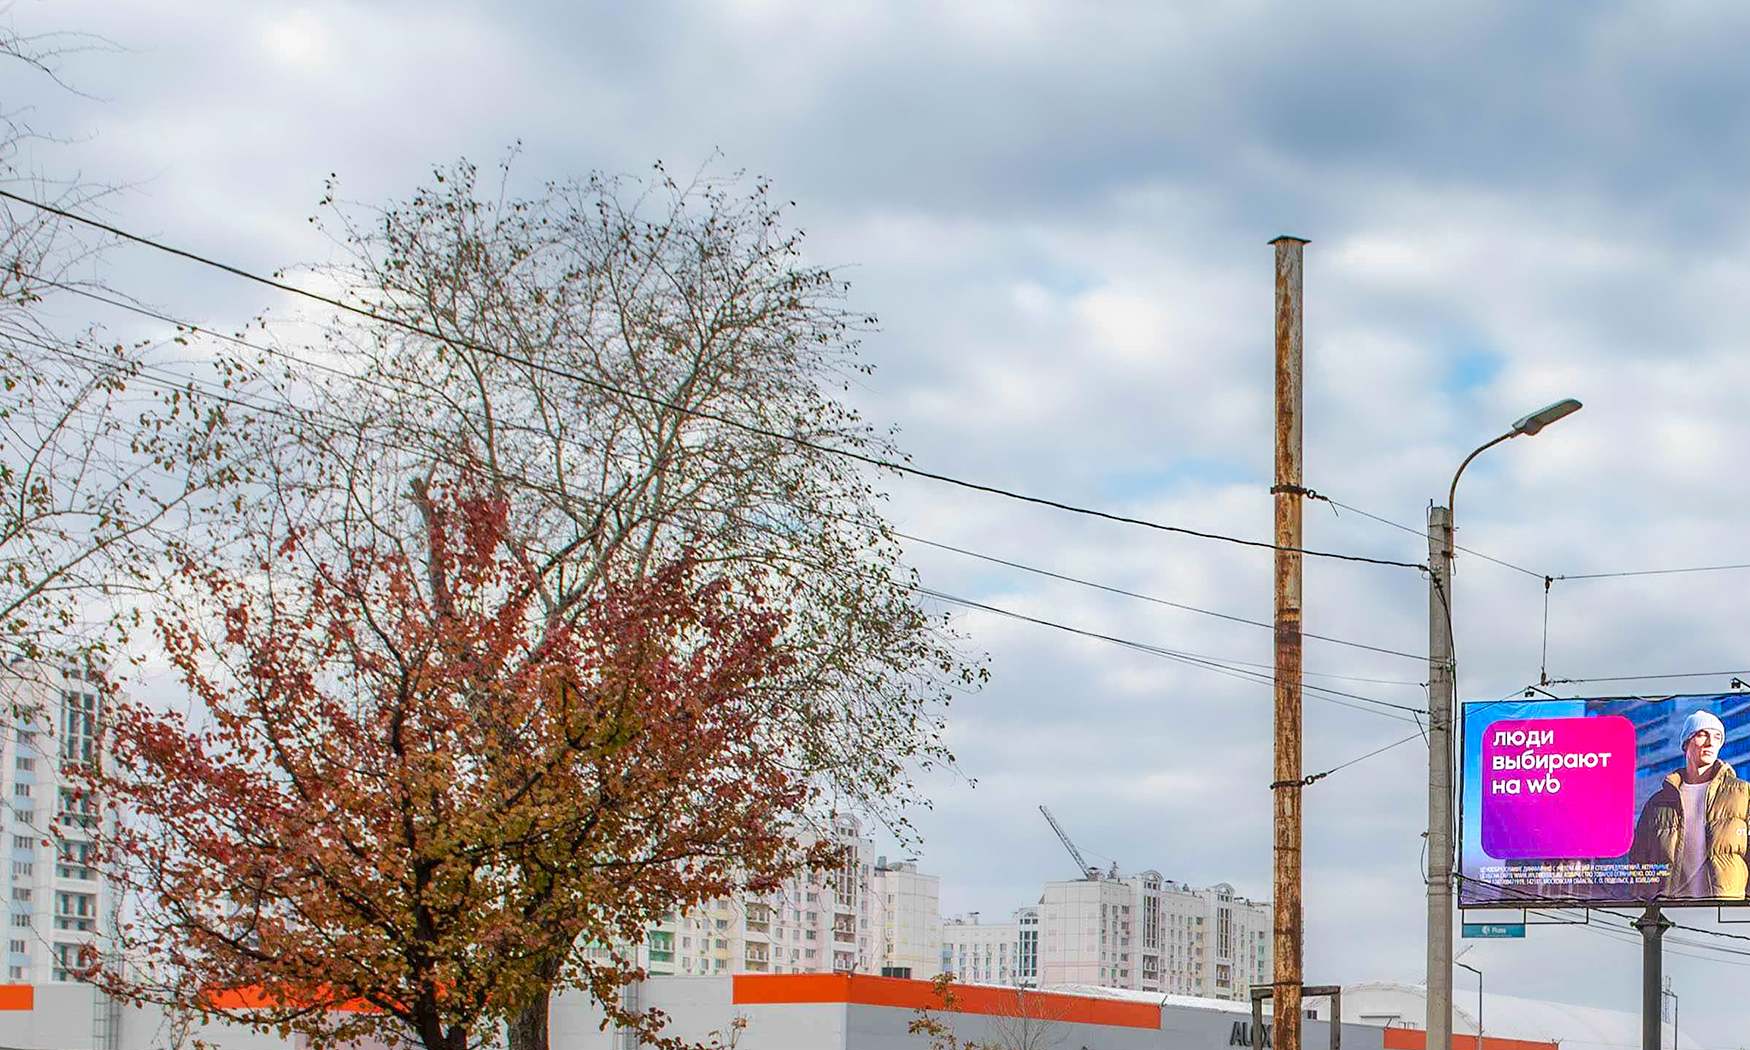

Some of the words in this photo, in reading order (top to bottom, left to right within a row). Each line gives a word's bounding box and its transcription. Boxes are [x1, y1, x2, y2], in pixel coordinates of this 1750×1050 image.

[1493, 730, 1554, 747] люди
[1492, 750, 1611, 773] выбирают
[1492, 780, 1520, 794] на
[1526, 773, 1560, 793] wb
[1230, 1021, 1272, 1048] ALX
